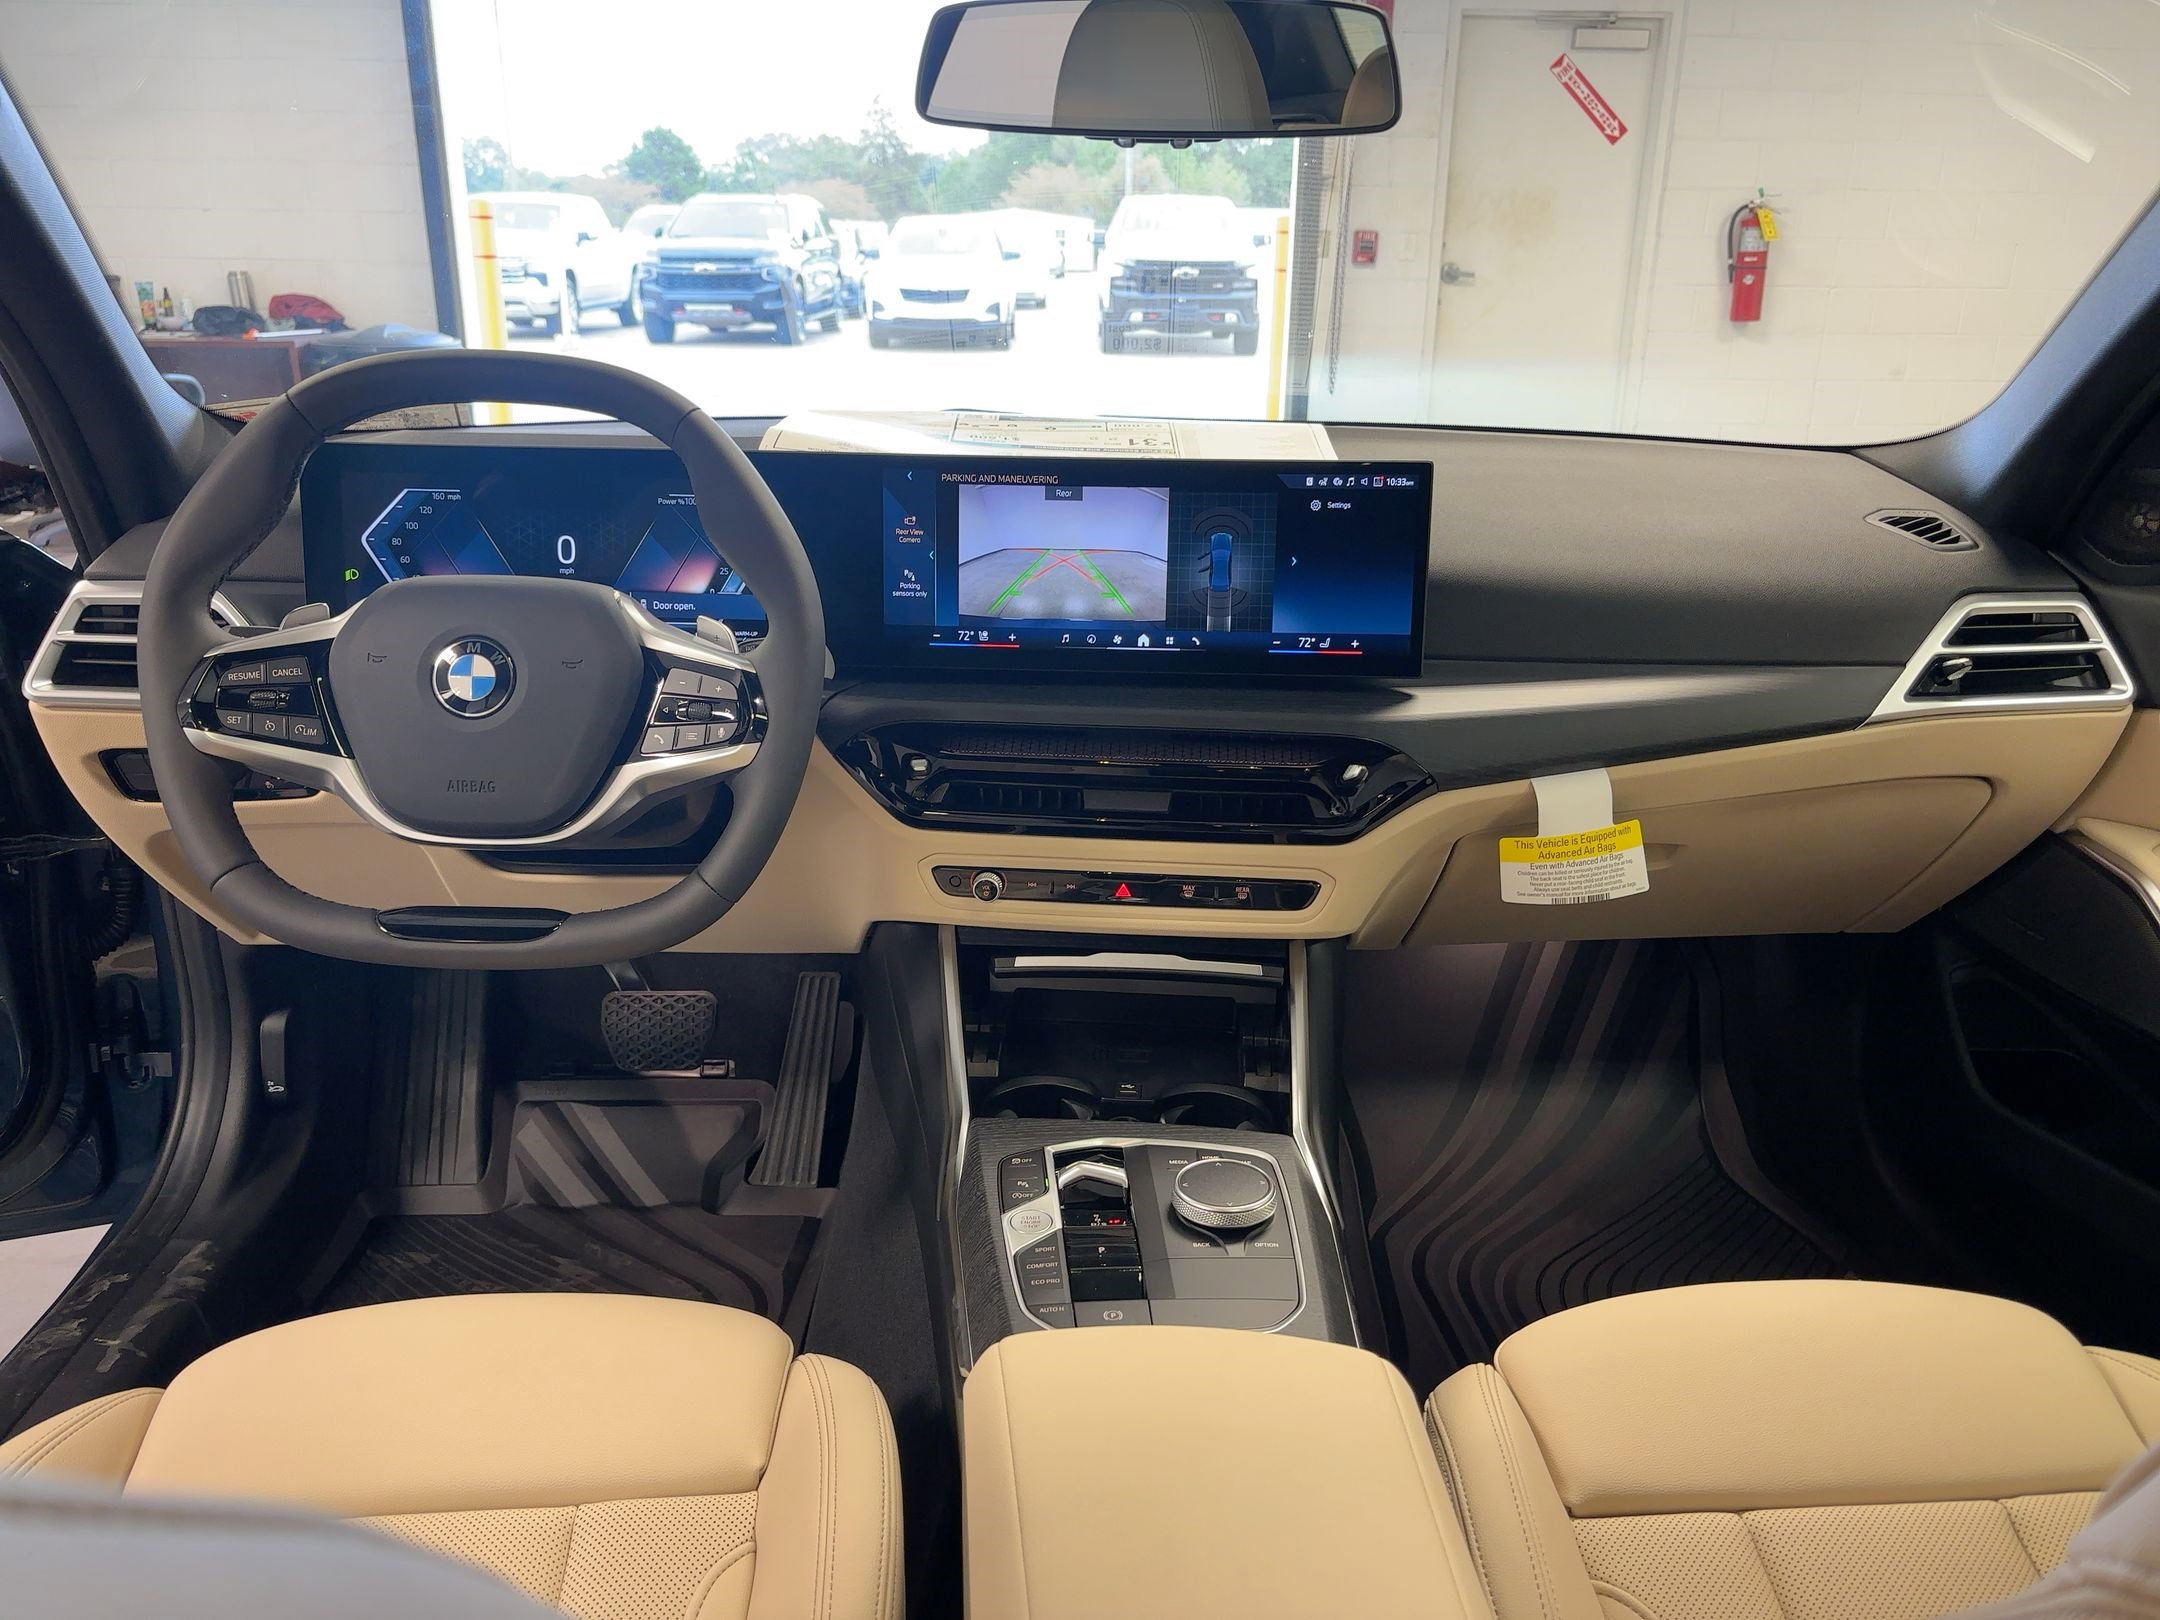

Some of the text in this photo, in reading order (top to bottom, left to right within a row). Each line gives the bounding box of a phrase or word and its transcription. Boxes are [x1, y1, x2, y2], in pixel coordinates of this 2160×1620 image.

[1557, 62, 1573, 80] FIRE
[941, 474, 1059, 485] PARKING AND MANEUVERING
[432, 492, 462, 502] 160 mph
[1056, 489, 1072, 498] Rear
[419, 506, 432, 514] 120
[1327, 501, 1352, 510] Settings
[405, 521, 418, 530] 100
[392, 538, 402, 546] 80
[556, 535, 576, 565] 0
[400, 555, 410, 564] 60
[720, 568, 729, 576] 25
[900, 582, 920, 591] Parking
[914, 590, 928, 598] only
[653, 601, 696, 613] Door open.
[228, 670, 260, 681] RESUME
[272, 668, 303, 677] CANCEL
[227, 716, 242, 724] SET
[303, 728, 318, 736] LIM
[446, 779, 497, 793] AIRBAG
[1514, 825, 1632, 849] This Vehicle is Equipped with
[1538, 843, 1616, 860] Advanced Air Bags
[1566, 857, 1598, 867] Advanced
[1600, 855, 1608, 863] Air
[1610, 853, 1624, 861] Bags
